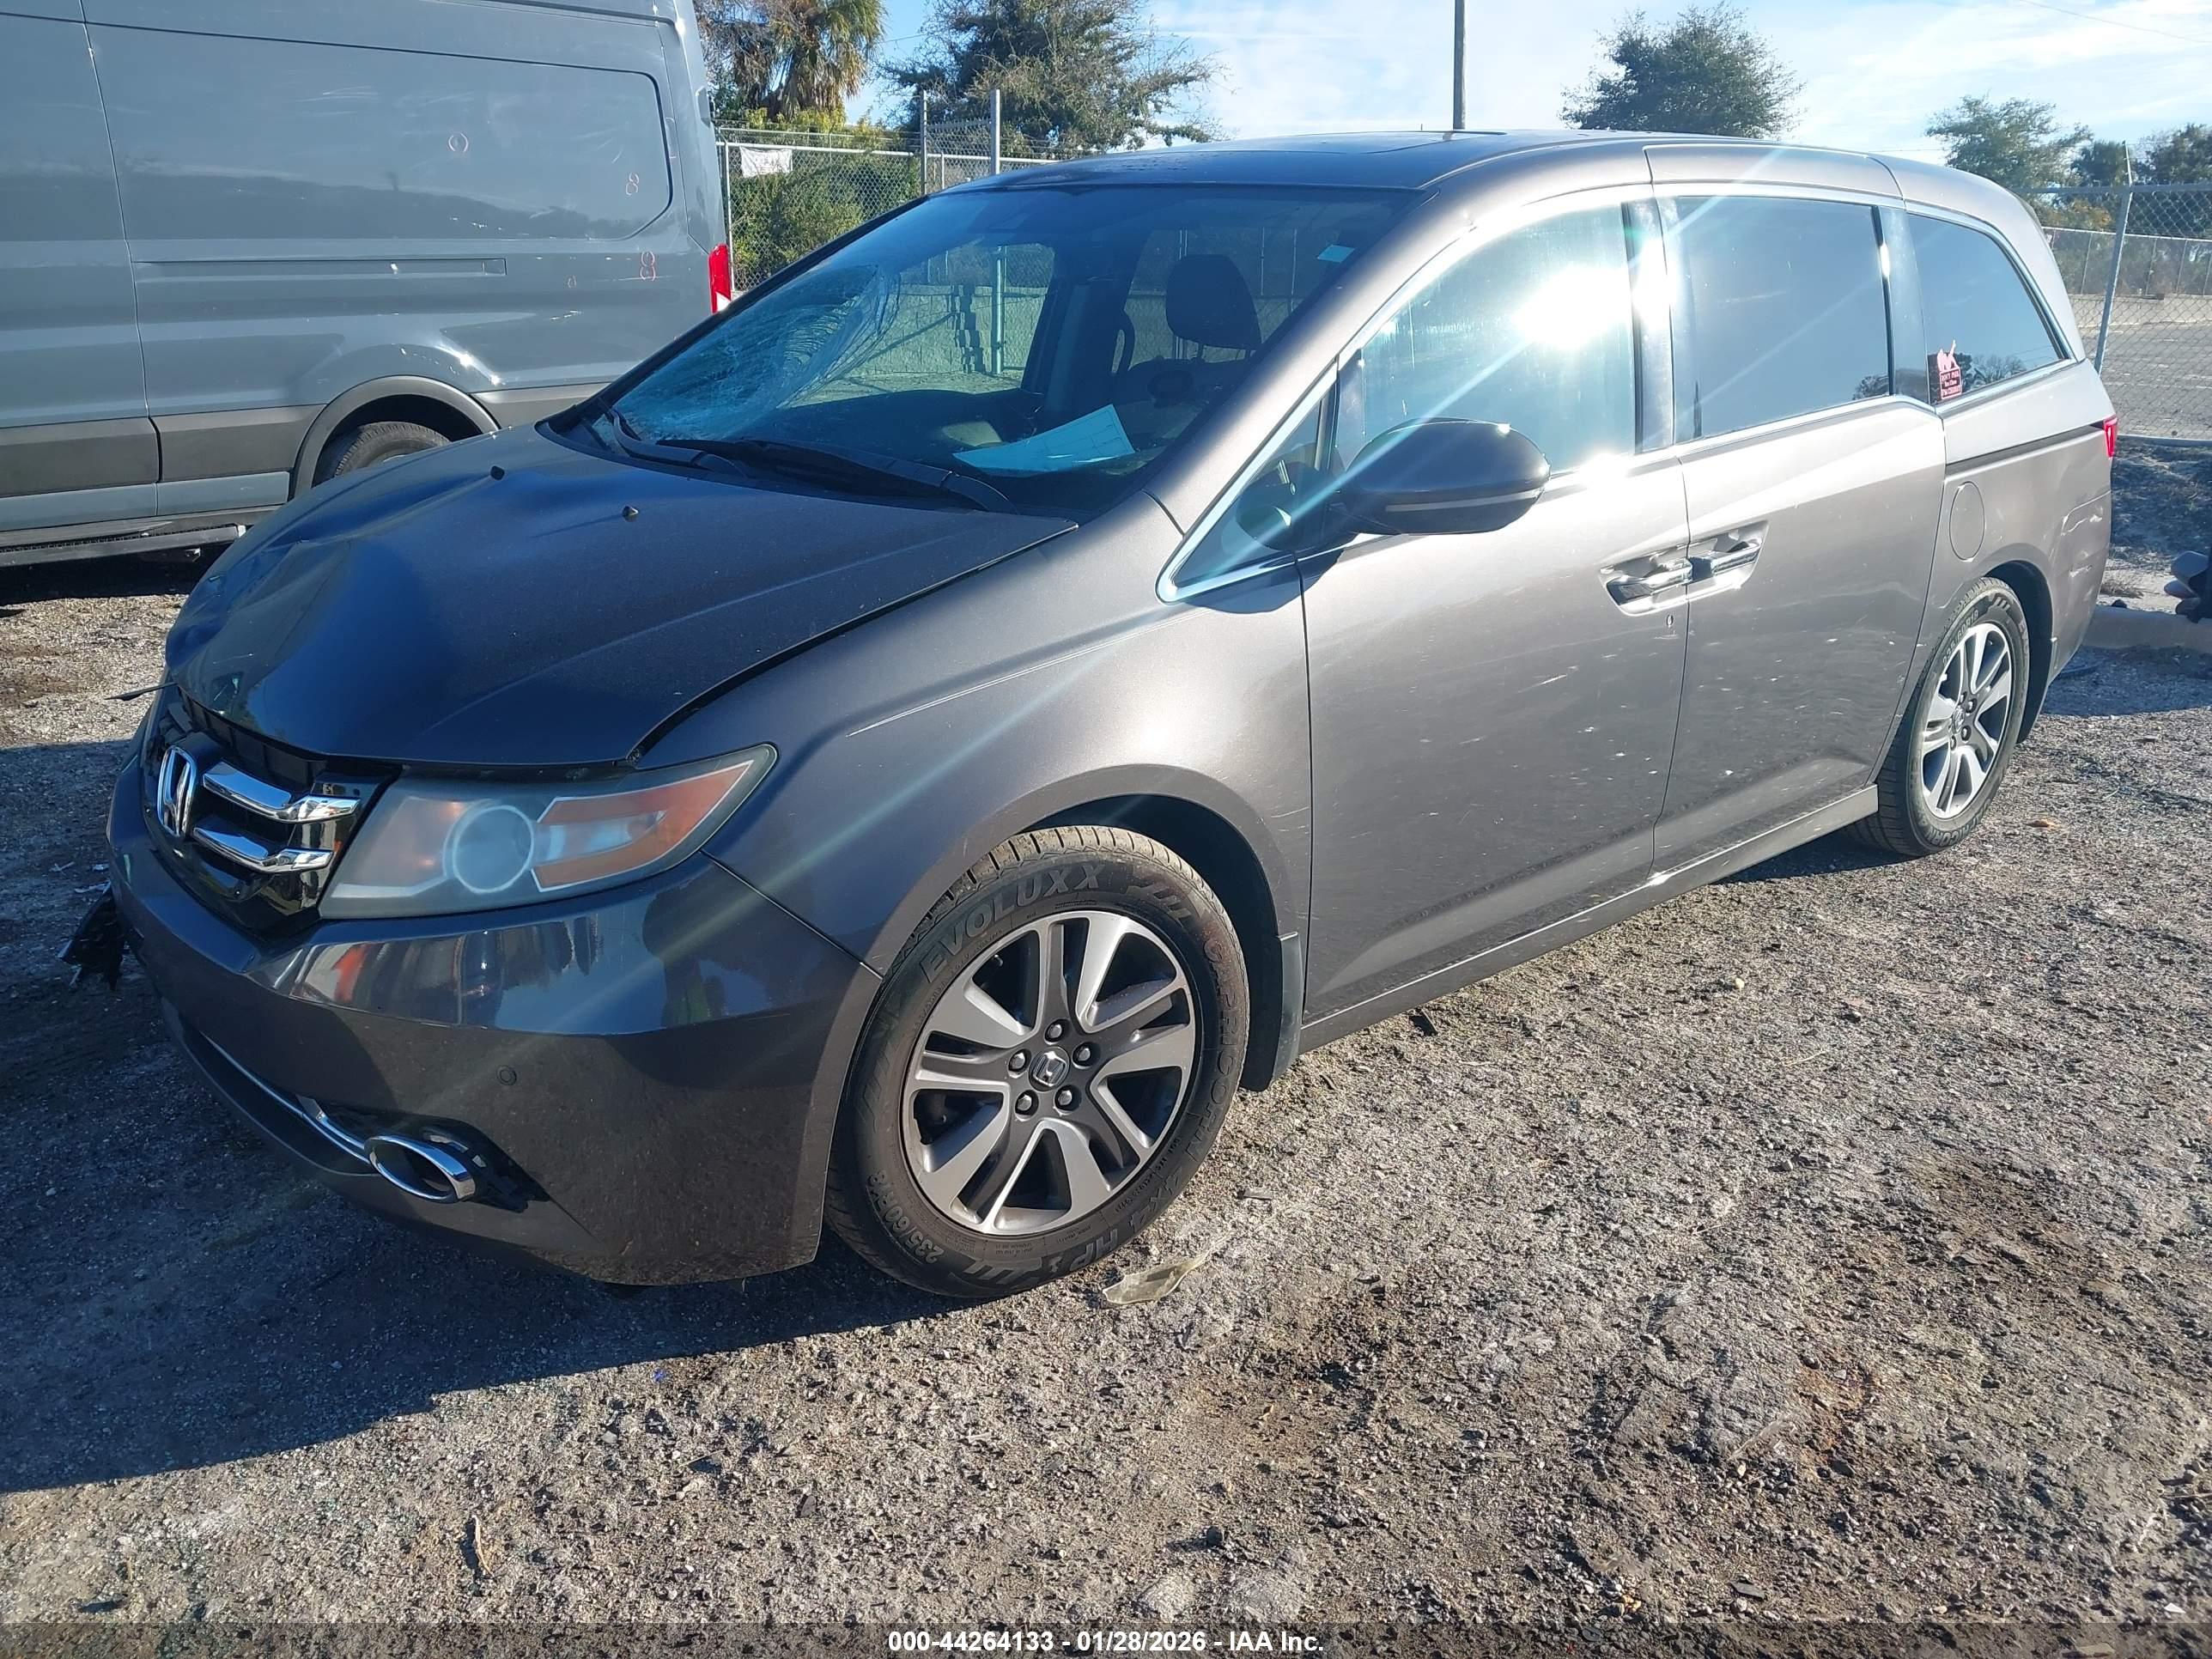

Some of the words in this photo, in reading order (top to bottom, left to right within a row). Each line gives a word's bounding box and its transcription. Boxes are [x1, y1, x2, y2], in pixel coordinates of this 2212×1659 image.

[919, 864, 1105, 983] EVOLUXX
[1183, 938, 1239, 1162] CAPRICORN
[867, 1170, 945, 1264] 235/60R18
[1070, 1229, 1118, 1271] HP
